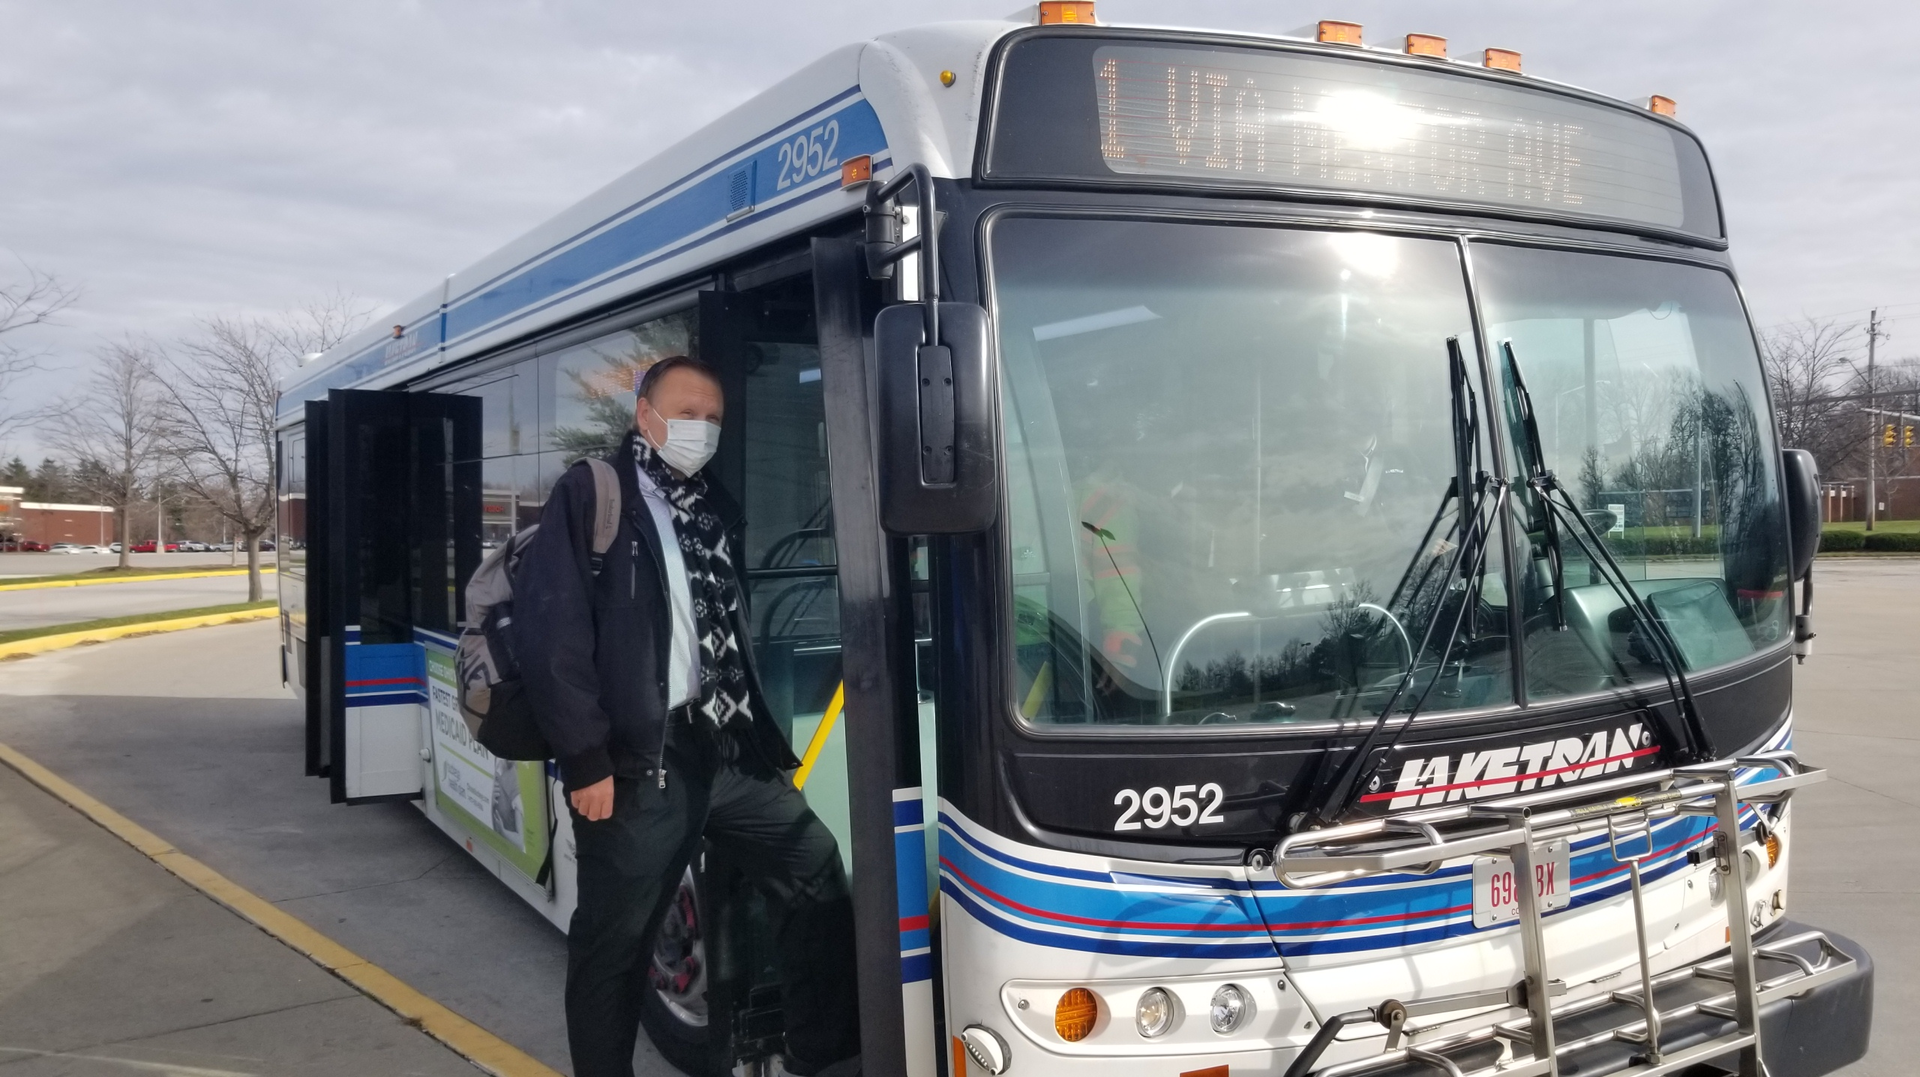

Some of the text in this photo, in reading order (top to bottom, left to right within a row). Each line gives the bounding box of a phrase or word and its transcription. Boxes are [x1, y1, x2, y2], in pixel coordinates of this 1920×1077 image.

[777, 119, 839, 191] 2952
[1100, 58, 1583, 205] 1 VIA MTOR AVE
[432, 686, 451, 708] FASTEST
[435, 708, 468, 747] MEDICAID
[1388, 722, 1643, 811] LAKETRAN
[1113, 782, 1225, 832] 2952
